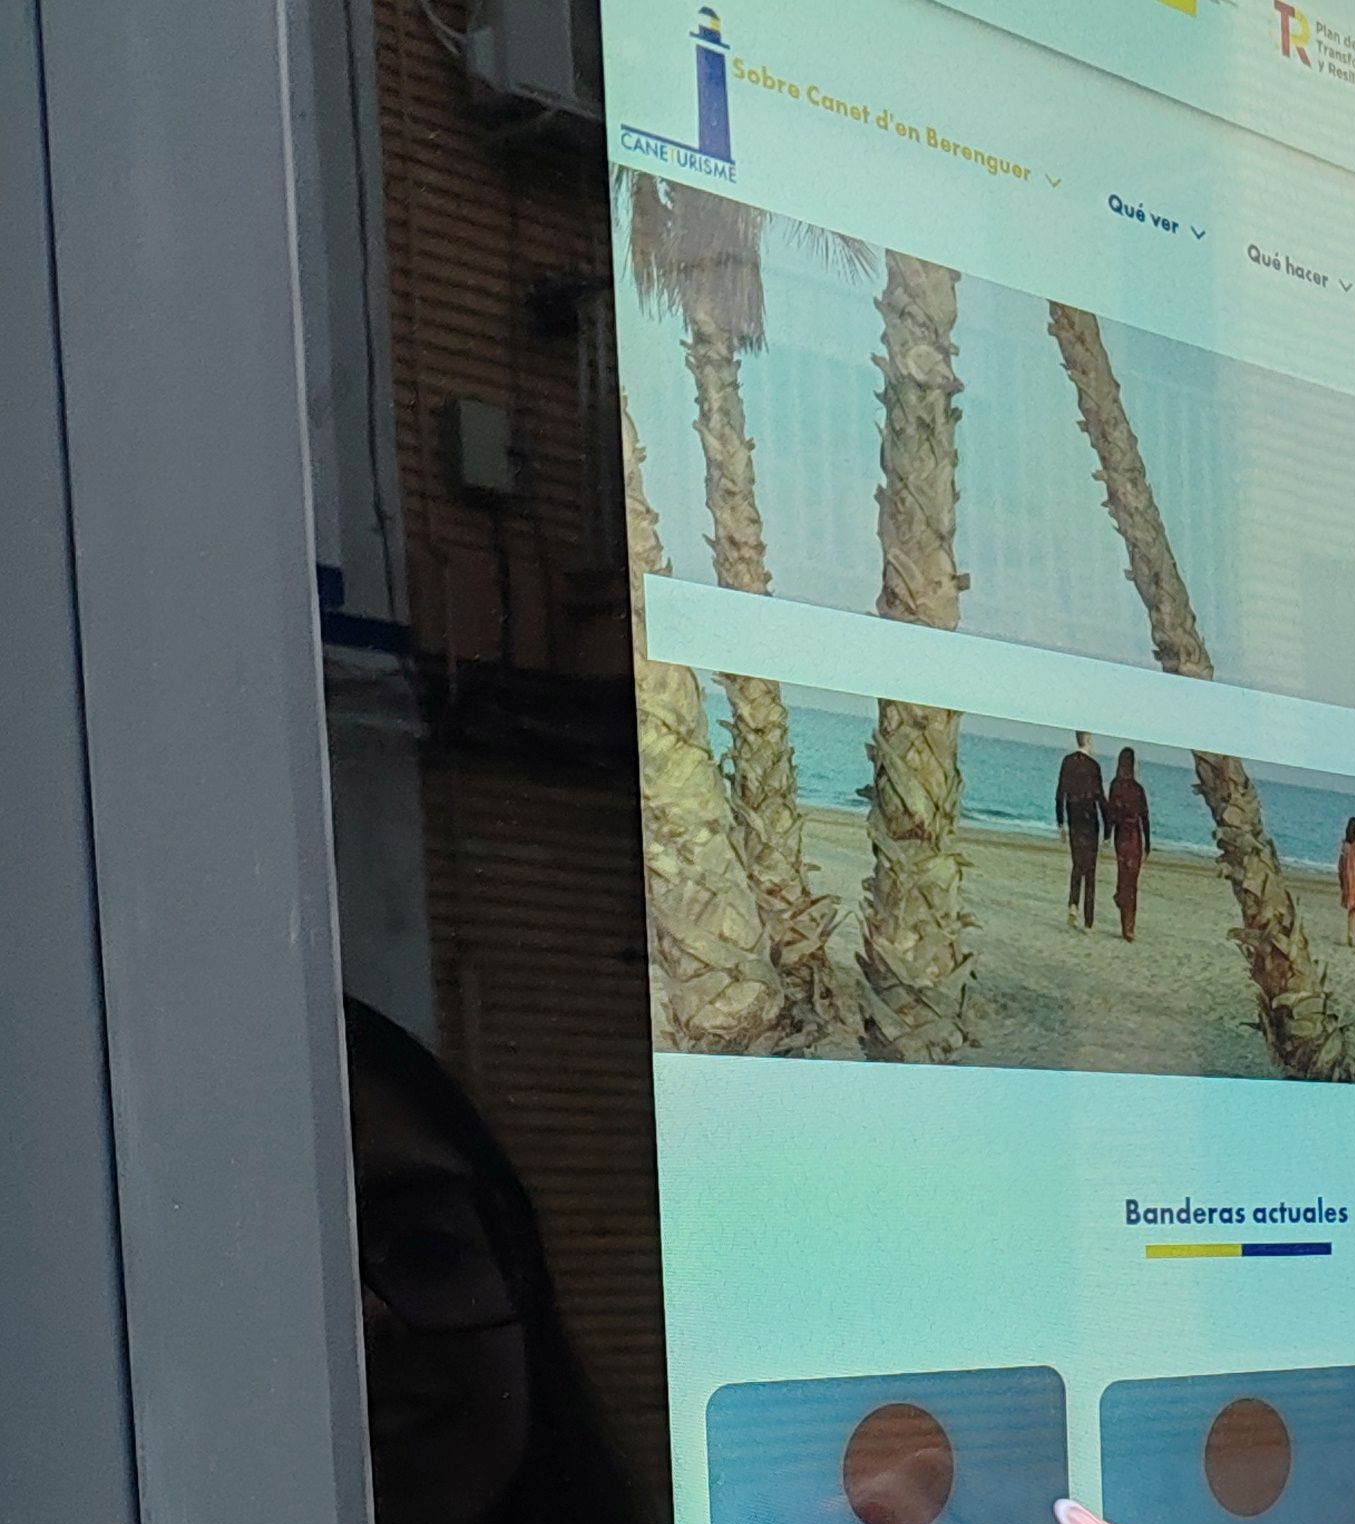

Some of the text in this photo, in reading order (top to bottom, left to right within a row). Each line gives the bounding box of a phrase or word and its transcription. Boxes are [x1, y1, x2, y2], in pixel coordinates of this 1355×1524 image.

[1316, 21, 1341, 45] Plan
[1318, 61, 1325, 73] y
[732, 57, 1032, 183] Sobre Canet d'en Berenguer
[1108, 193, 1180, 235] Qué ver
[1247, 244, 1329, 288] Qué hacer
[1125, 1196, 1349, 1225] Banderas actuales
